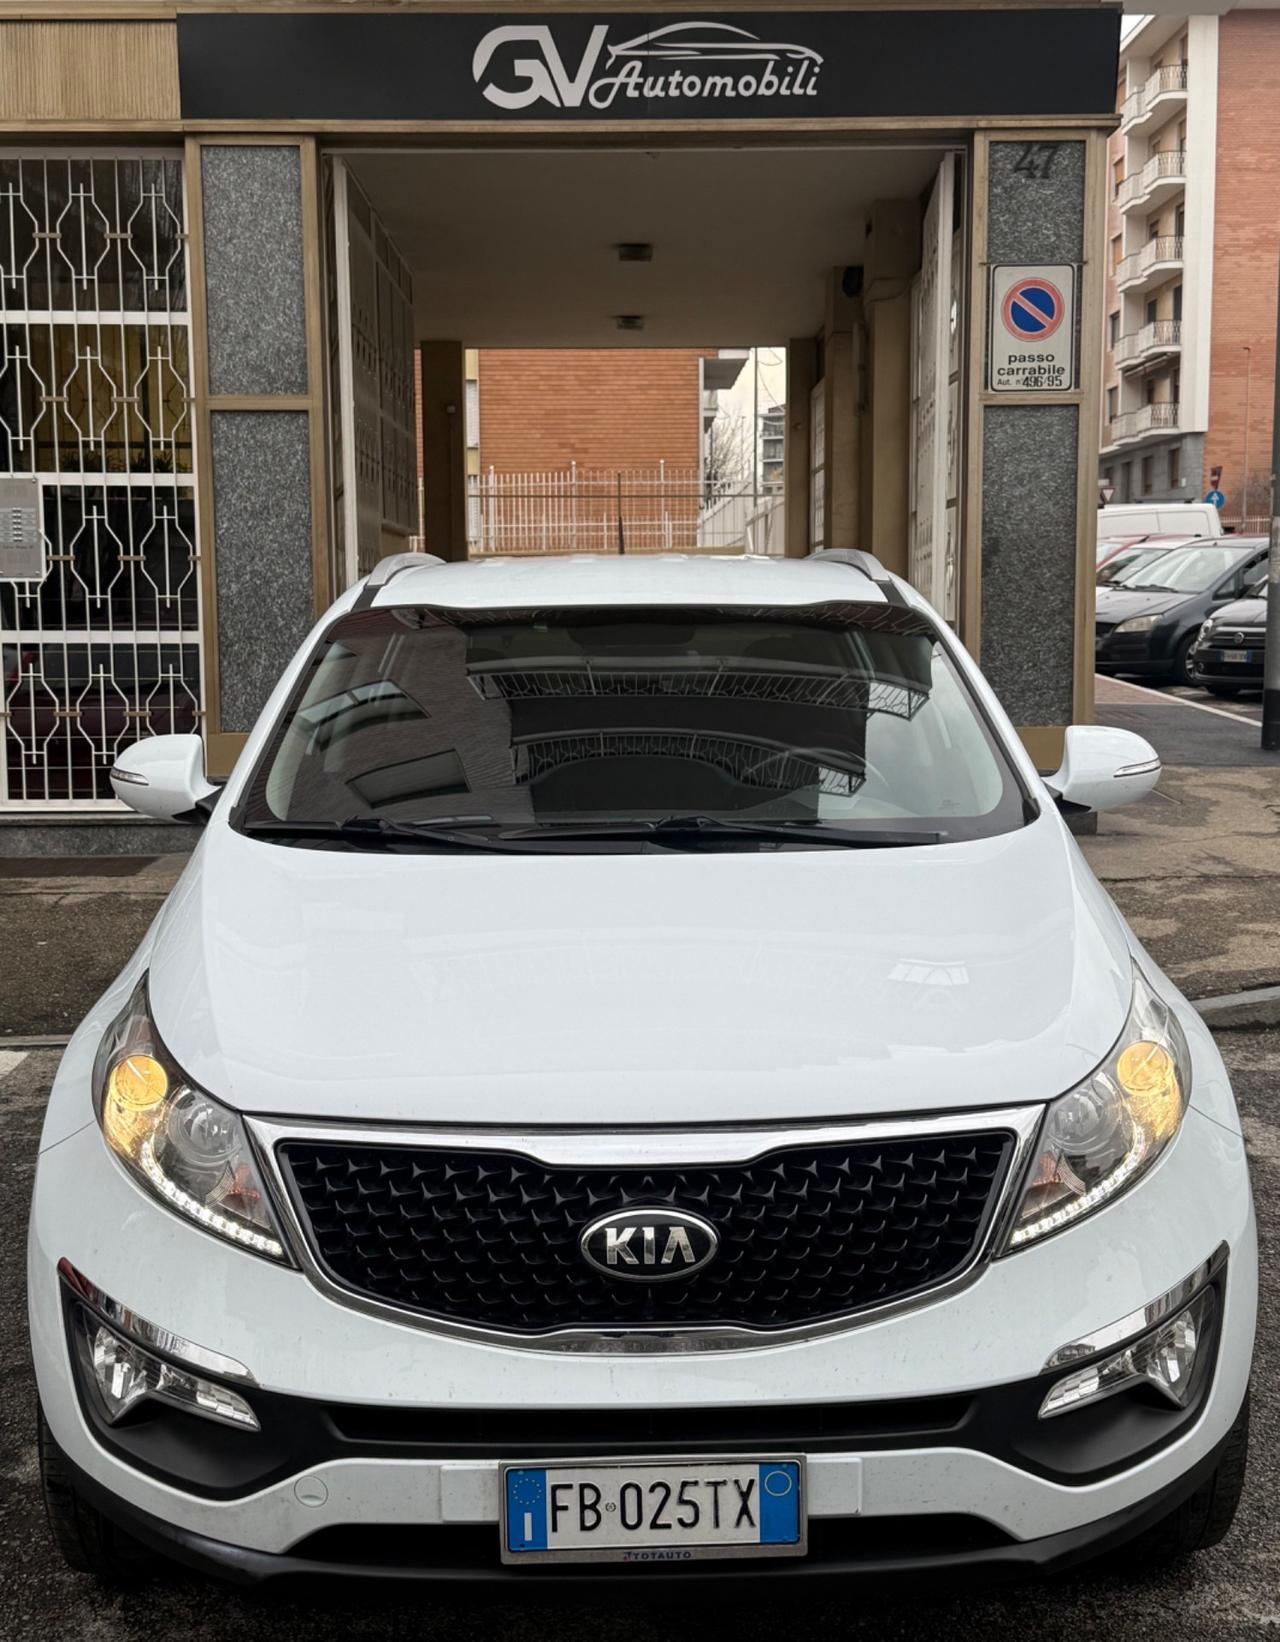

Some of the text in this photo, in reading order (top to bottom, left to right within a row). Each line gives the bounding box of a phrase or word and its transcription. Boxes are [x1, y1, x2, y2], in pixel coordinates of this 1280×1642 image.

[472, 24, 821, 109] GV Automobili
[1013, 140, 1058, 179] 47
[997, 365, 1065, 376] carrabile
[1008, 354, 1055, 366] passo
[605, 1226, 696, 1264] KIA
